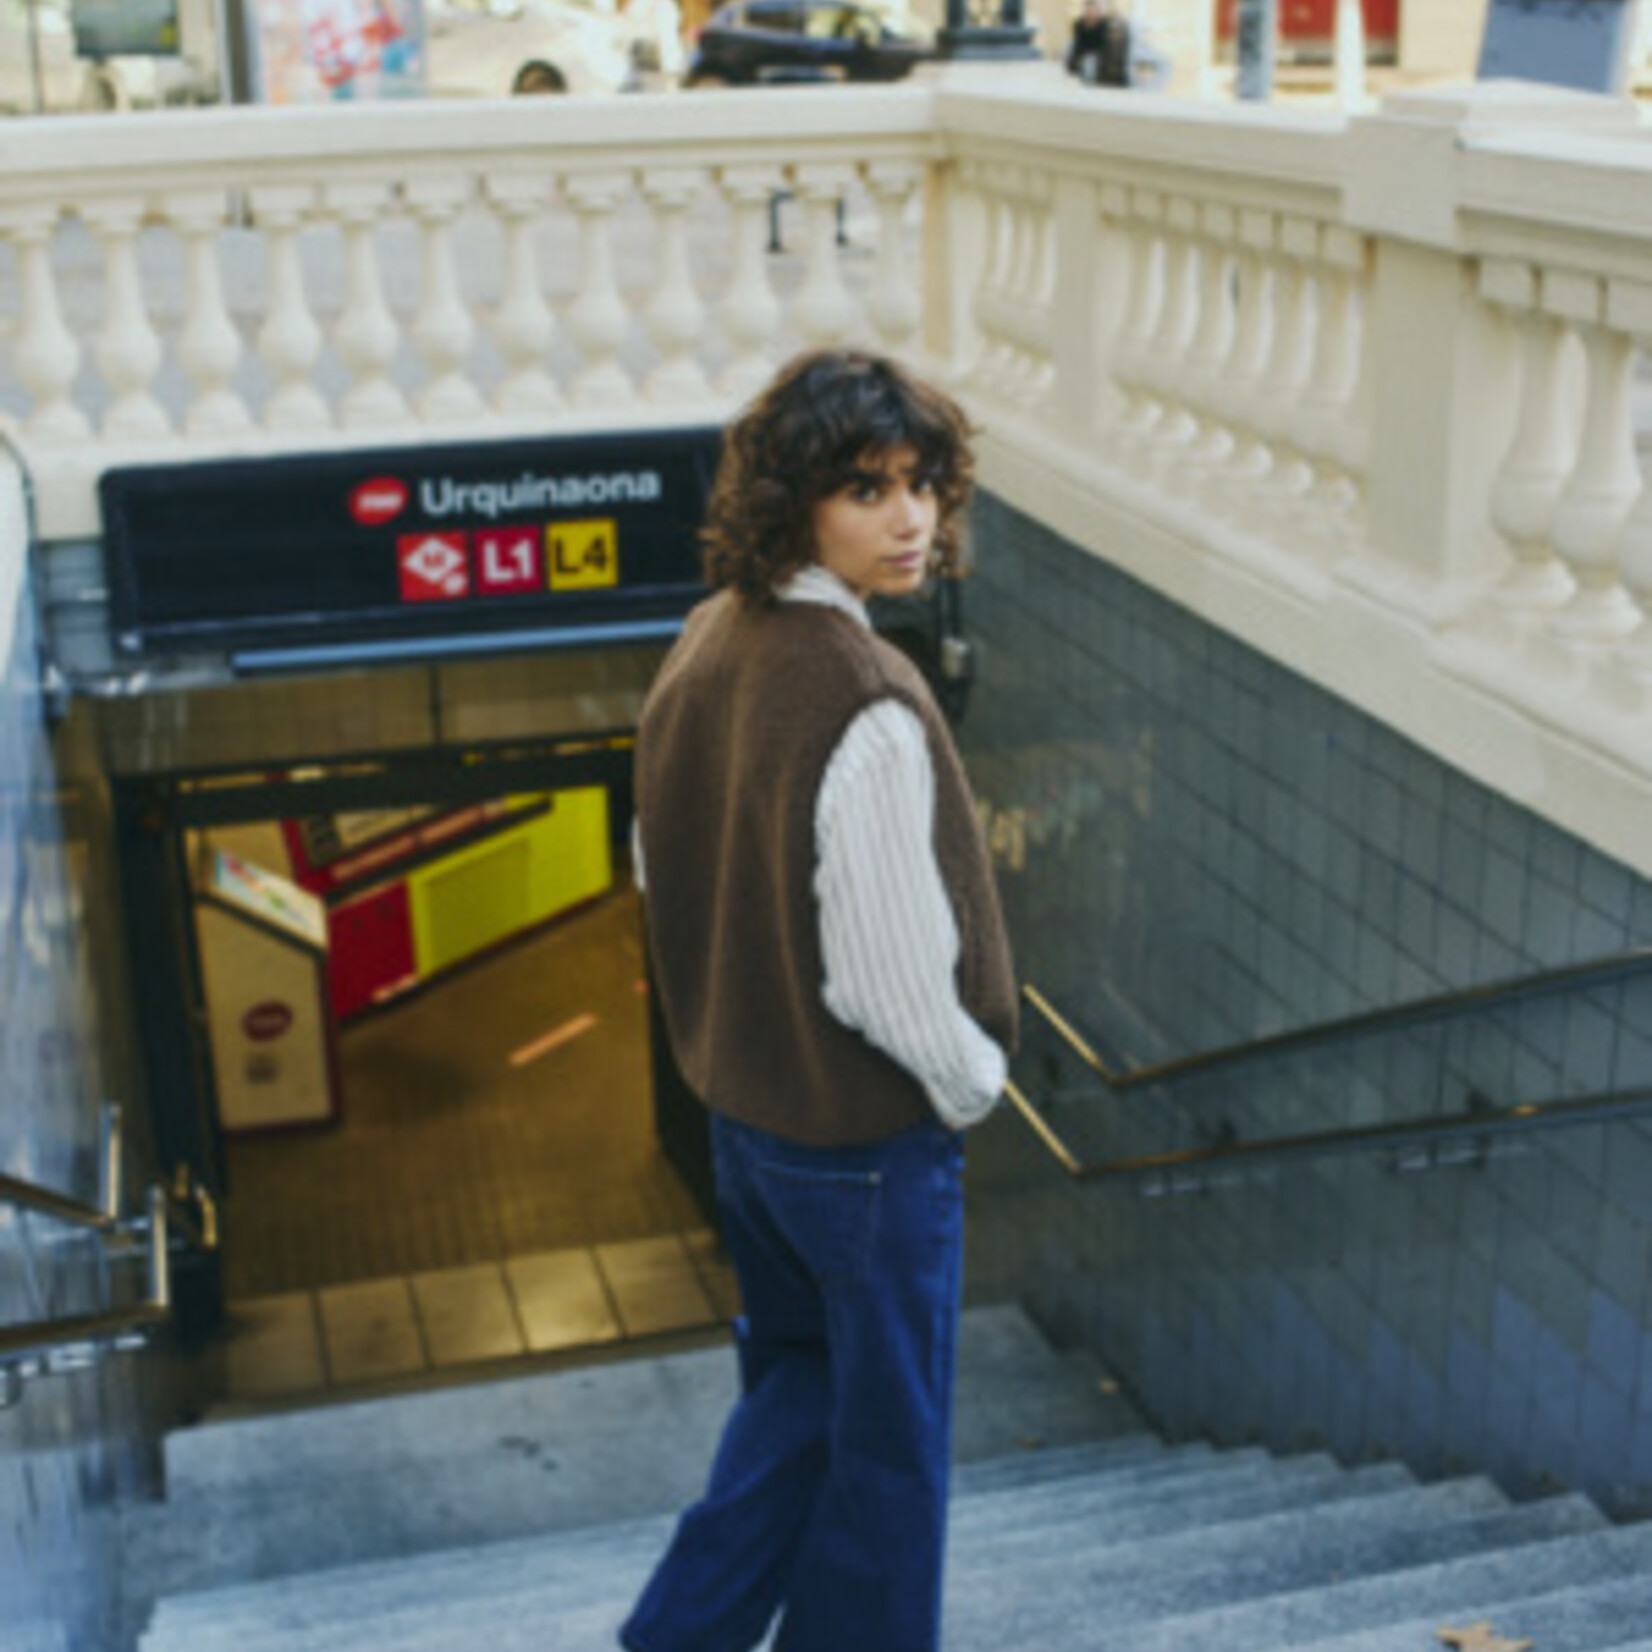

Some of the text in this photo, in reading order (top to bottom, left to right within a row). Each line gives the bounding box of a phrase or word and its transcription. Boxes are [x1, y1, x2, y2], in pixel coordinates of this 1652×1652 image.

[421, 471, 660, 517] Urquinaona
[483, 539, 533, 582] L1
[555, 536, 609, 574] L4
